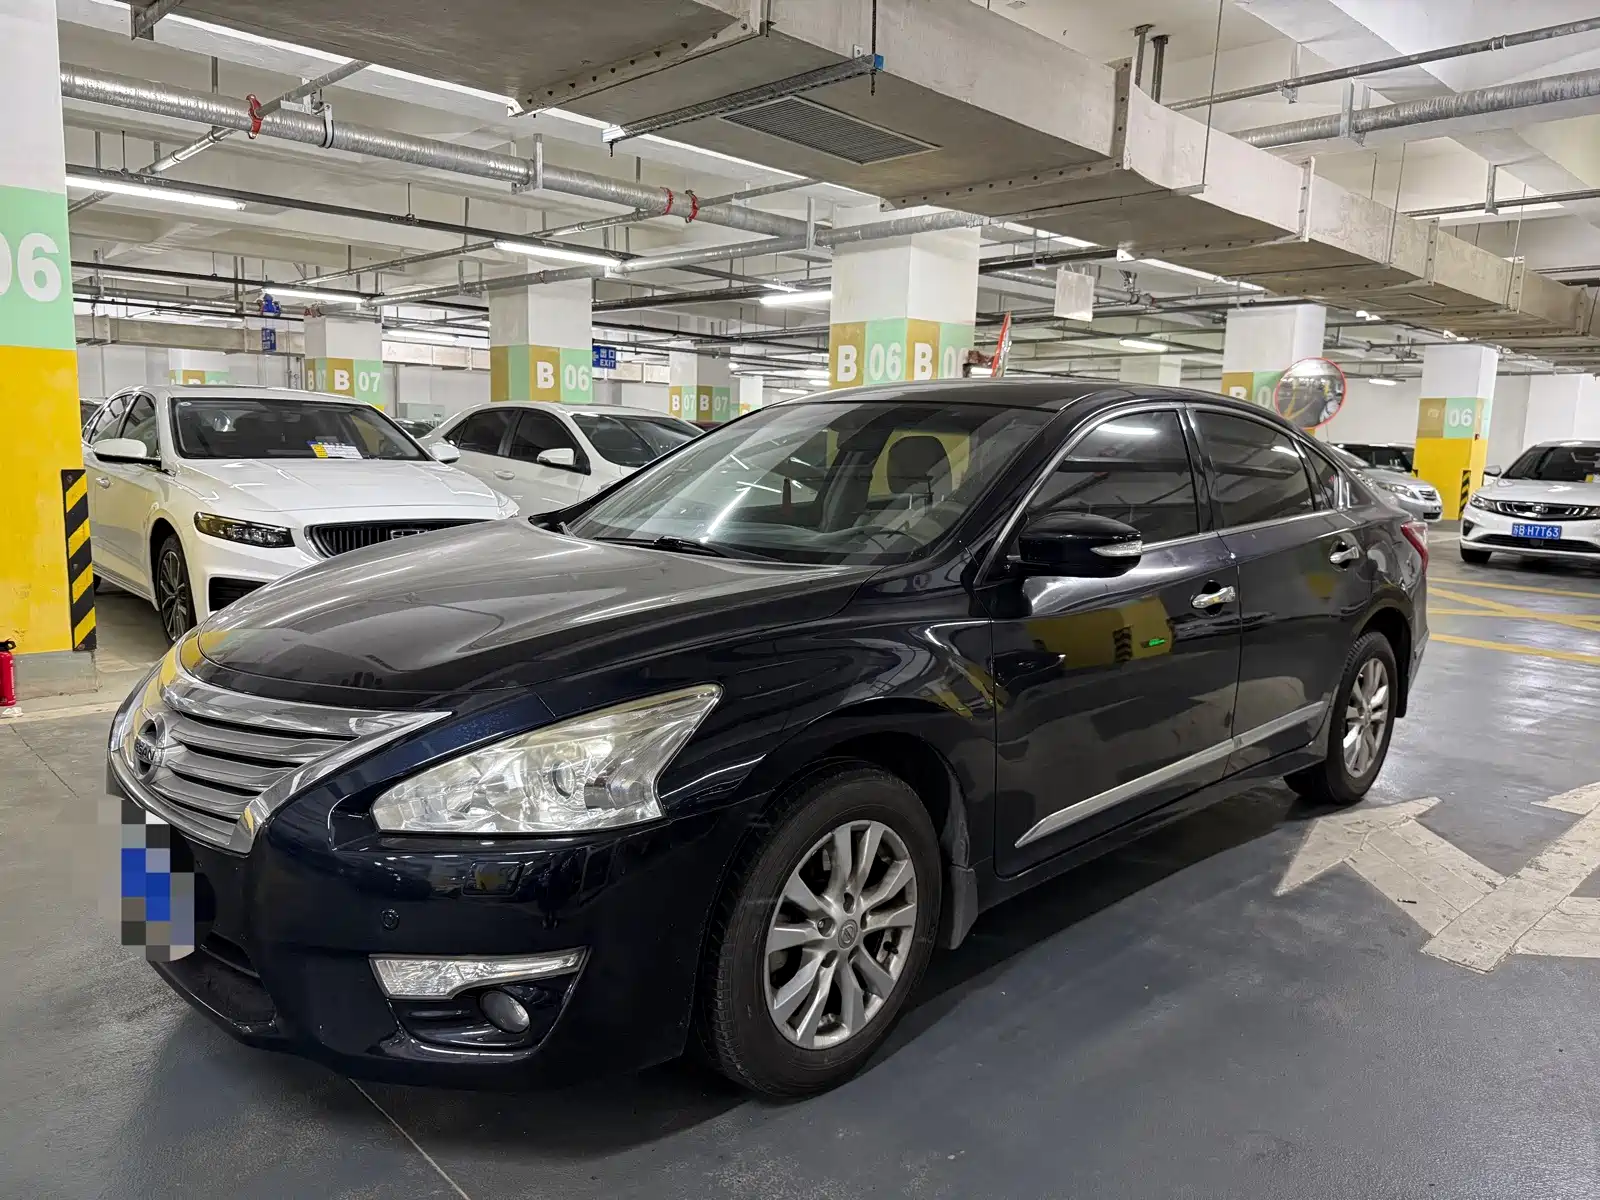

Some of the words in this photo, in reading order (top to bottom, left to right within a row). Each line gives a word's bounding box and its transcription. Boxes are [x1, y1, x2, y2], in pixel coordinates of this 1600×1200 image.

[0, 230, 61, 302] 6
[599, 348, 615, 359] 出口
[599, 359, 615, 368] EXIT
[837, 345, 857, 382] B
[869, 342, 902, 380] 06
[914, 342, 933, 380] B
[334, 369, 350, 391] B
[358, 371, 381, 393] 07
[536, 361, 554, 389] B
[564, 364, 590, 392] 06
[671, 394, 681, 411] B
[683, 393, 697, 412] 07
[700, 394, 710, 412] B
[714, 395, 729, 412] 07
[1448, 407, 1473, 428] 06
